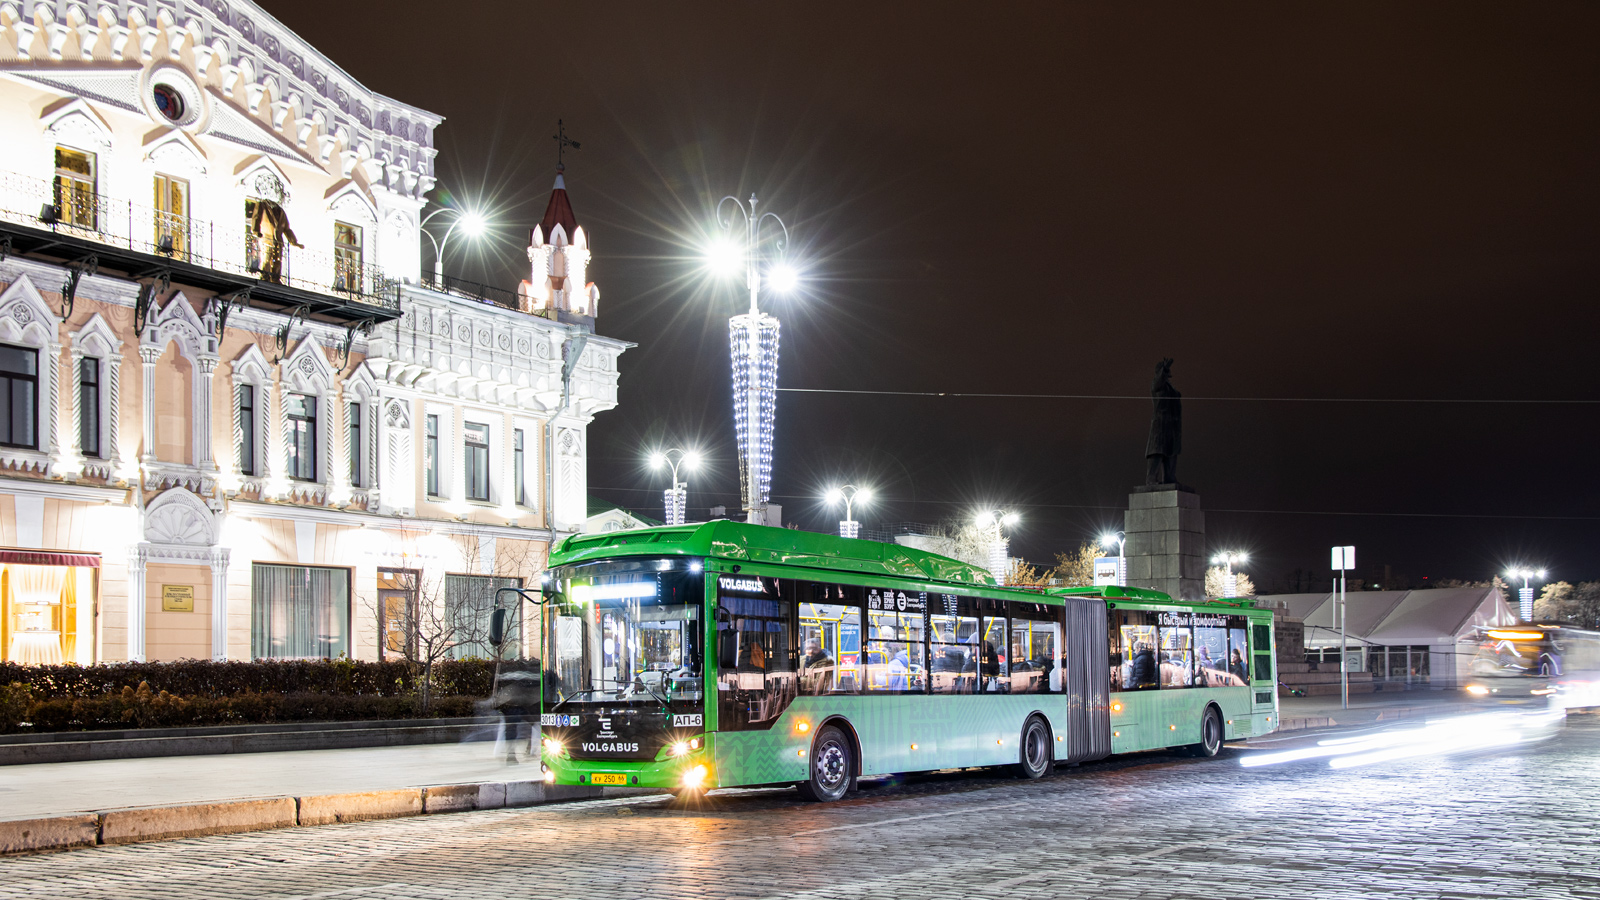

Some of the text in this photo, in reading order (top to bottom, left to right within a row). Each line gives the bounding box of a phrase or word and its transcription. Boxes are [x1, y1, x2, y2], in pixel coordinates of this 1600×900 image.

[720, 578, 762, 592] VOLGABUS
[1158, 613, 1163, 625] Я
[1163, 613, 1188, 628] быстрый
[542, 715, 555, 724] 3013
[675, 717, 701, 725] АП-6
[582, 742, 639, 752] VOLGABUS
[603, 774, 616, 783] 250
